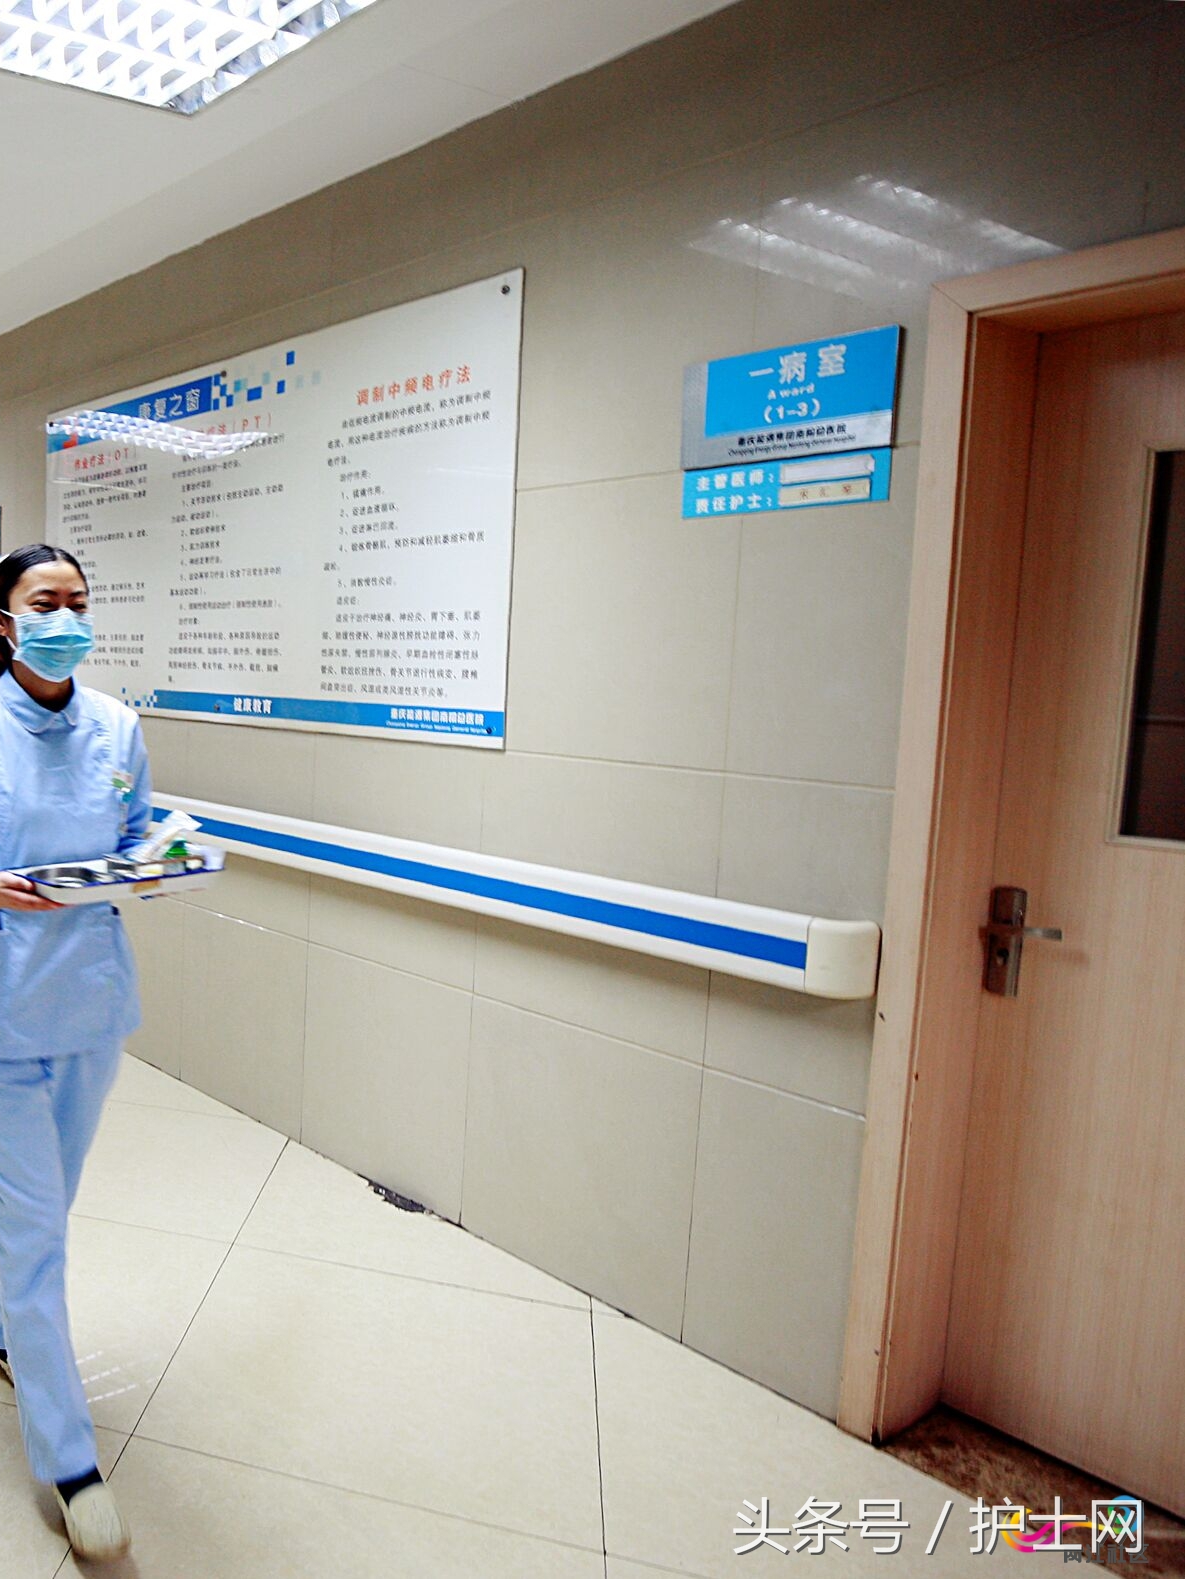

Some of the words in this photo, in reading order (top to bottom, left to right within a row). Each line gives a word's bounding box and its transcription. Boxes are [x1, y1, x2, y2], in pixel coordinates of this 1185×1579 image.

[748, 344, 847, 384] 一病室
[356, 364, 471, 406] 调制中频电疗法
[138, 388, 201, 421] 康复之窗
[233, 697, 272, 714] 健康教育
